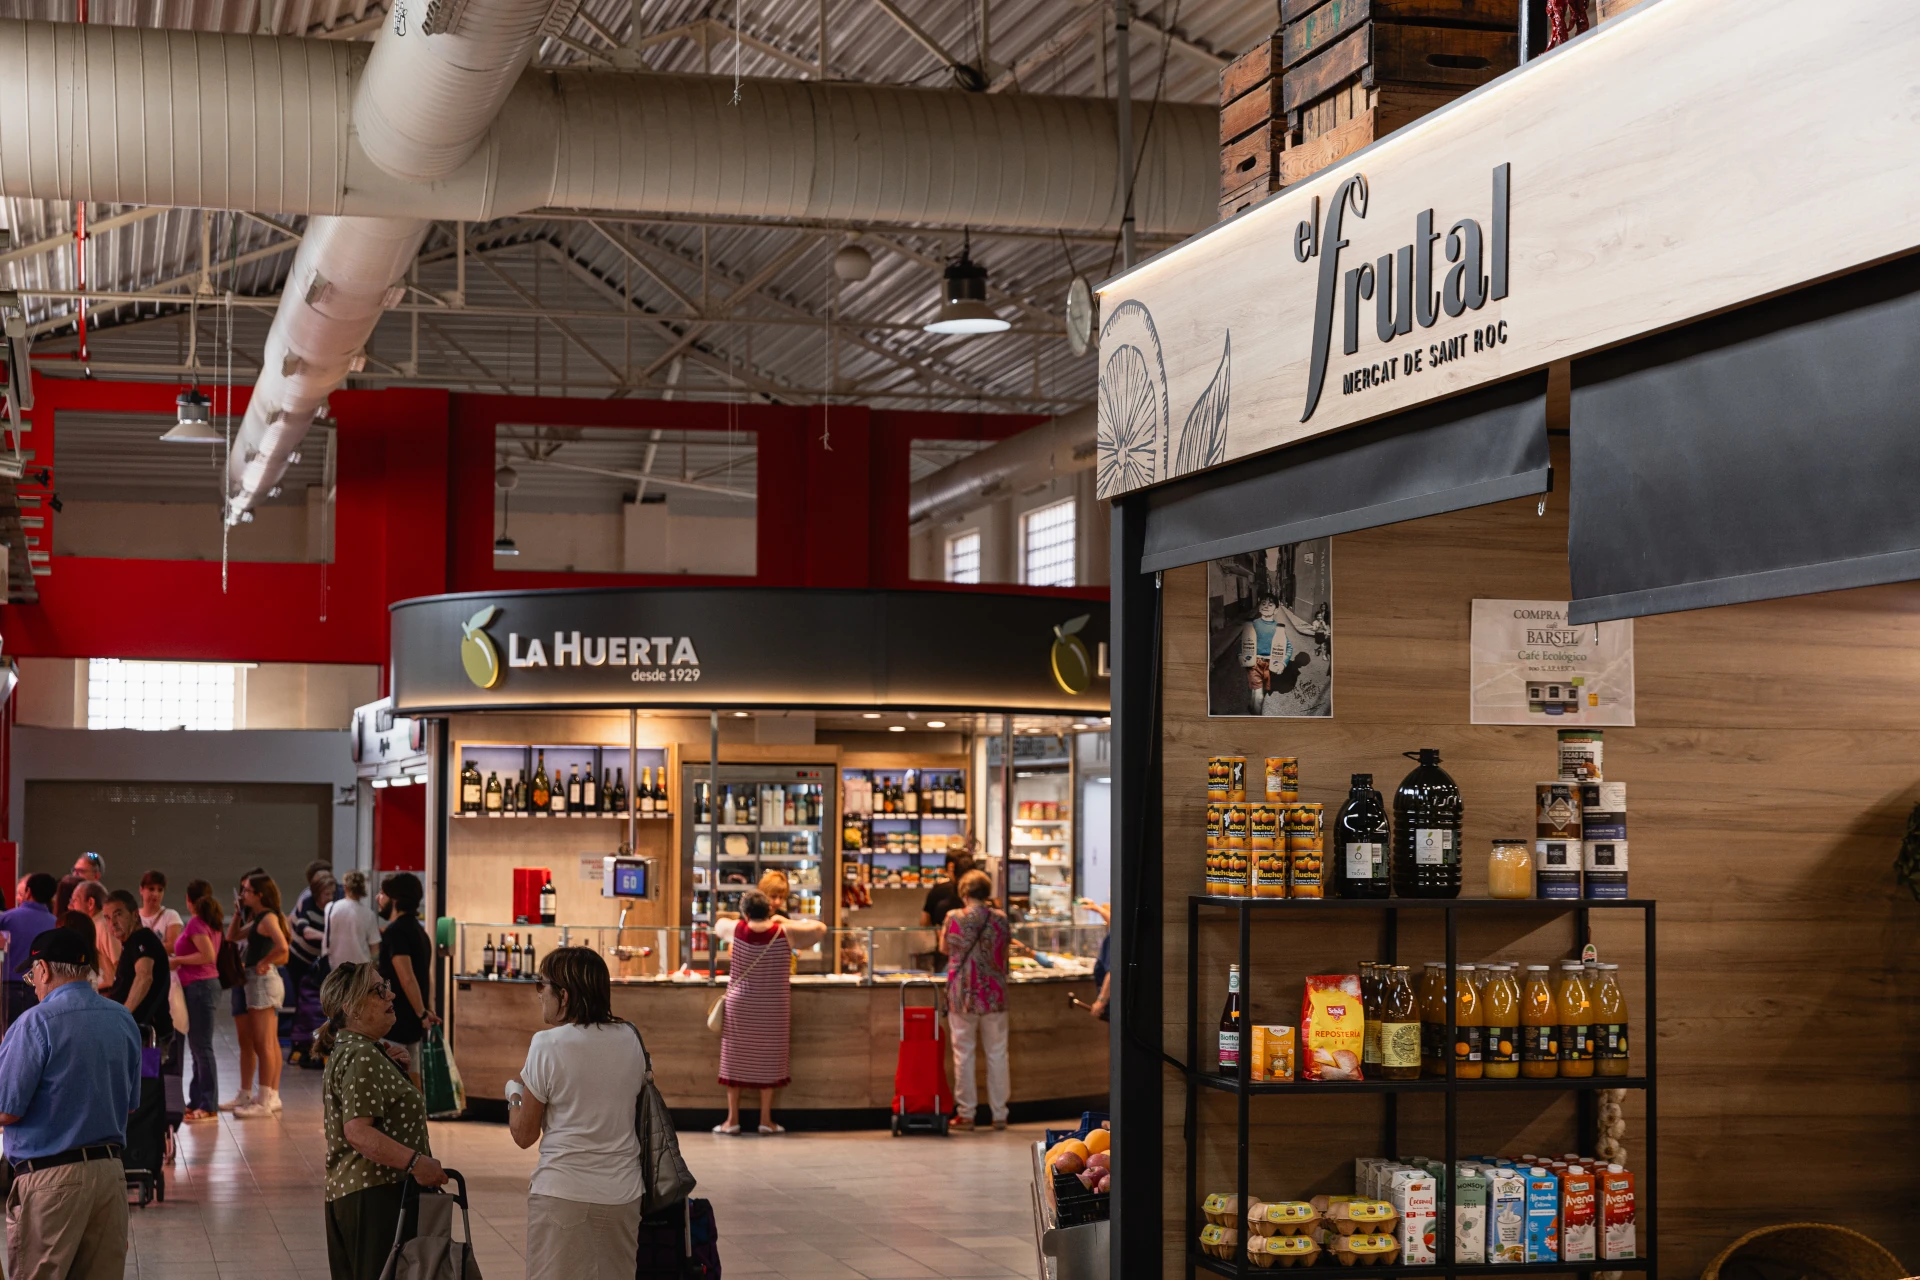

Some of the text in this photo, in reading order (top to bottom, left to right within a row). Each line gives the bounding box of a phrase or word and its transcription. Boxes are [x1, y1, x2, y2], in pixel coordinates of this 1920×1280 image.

[1294, 161, 1510, 423] el frutal
[1343, 320, 1508, 395] MERCAT DE SANT ROC
[1513, 609, 1560, 620] COMPRA
[1526, 631, 1578, 646] BARSEL
[1518, 650, 1587, 664] Café Ecológico
[631, 668, 700, 682] desde 1929
[1258, 869, 1284, 880] Ruchey
[1295, 869, 1320, 880] Ruchey
[623, 875, 637, 889] 60
[1457, 1182, 1484, 1190] MONSOY
[1566, 1194, 1595, 1208] Avena
[1606, 1193, 1634, 1206] Avena
